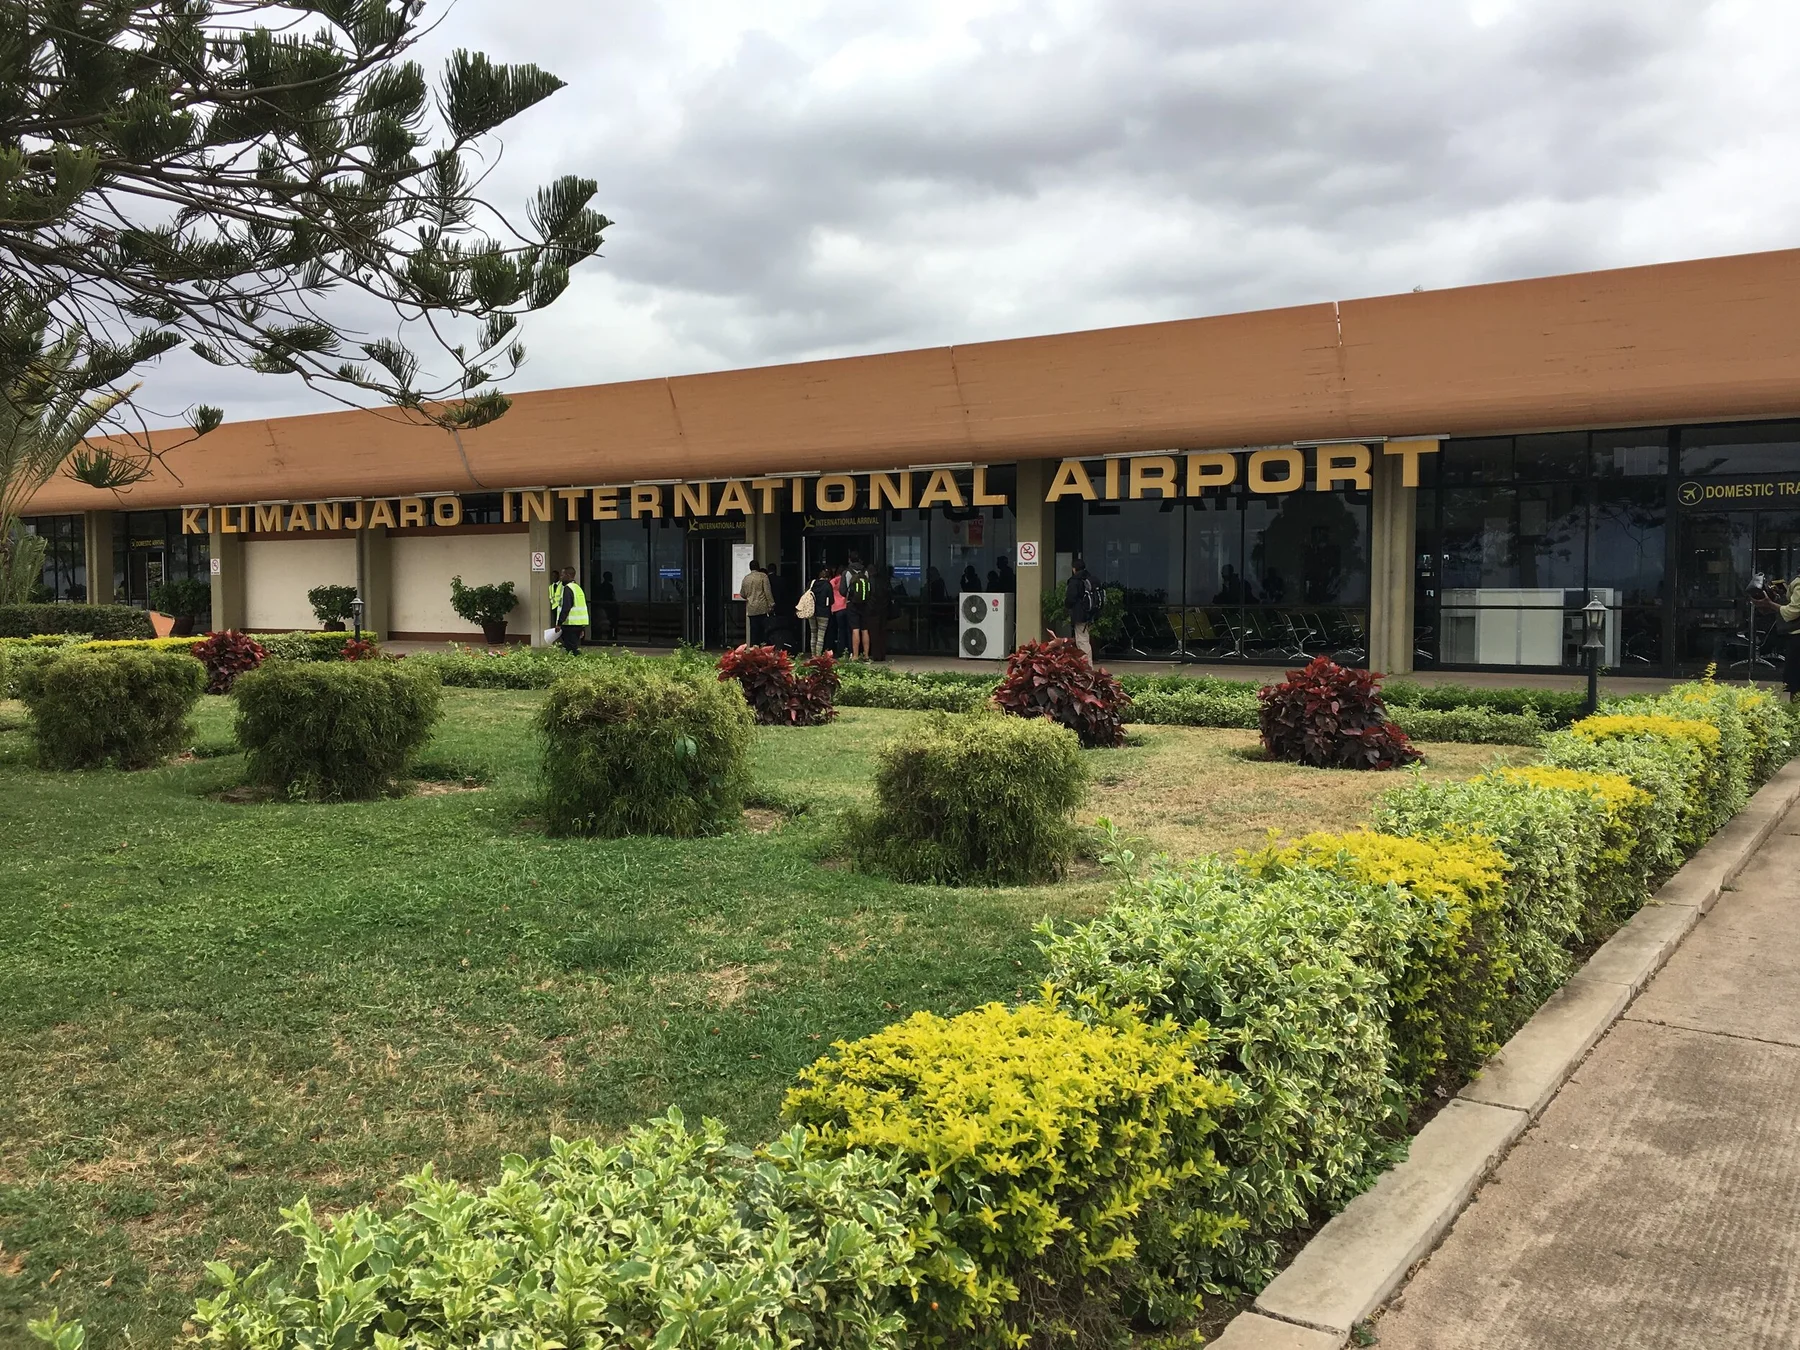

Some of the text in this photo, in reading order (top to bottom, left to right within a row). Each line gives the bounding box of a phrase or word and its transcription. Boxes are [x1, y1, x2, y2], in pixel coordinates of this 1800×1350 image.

[181, 439, 1441, 535] KILIMANJARO INTERNATIONAL AIRPORT
[1705, 483, 1774, 499] DOMESTIC
[698, 521, 735, 530] INTERNATIONAL
[815, 516, 880, 527] INTERNATIONAL ARRIVAL
